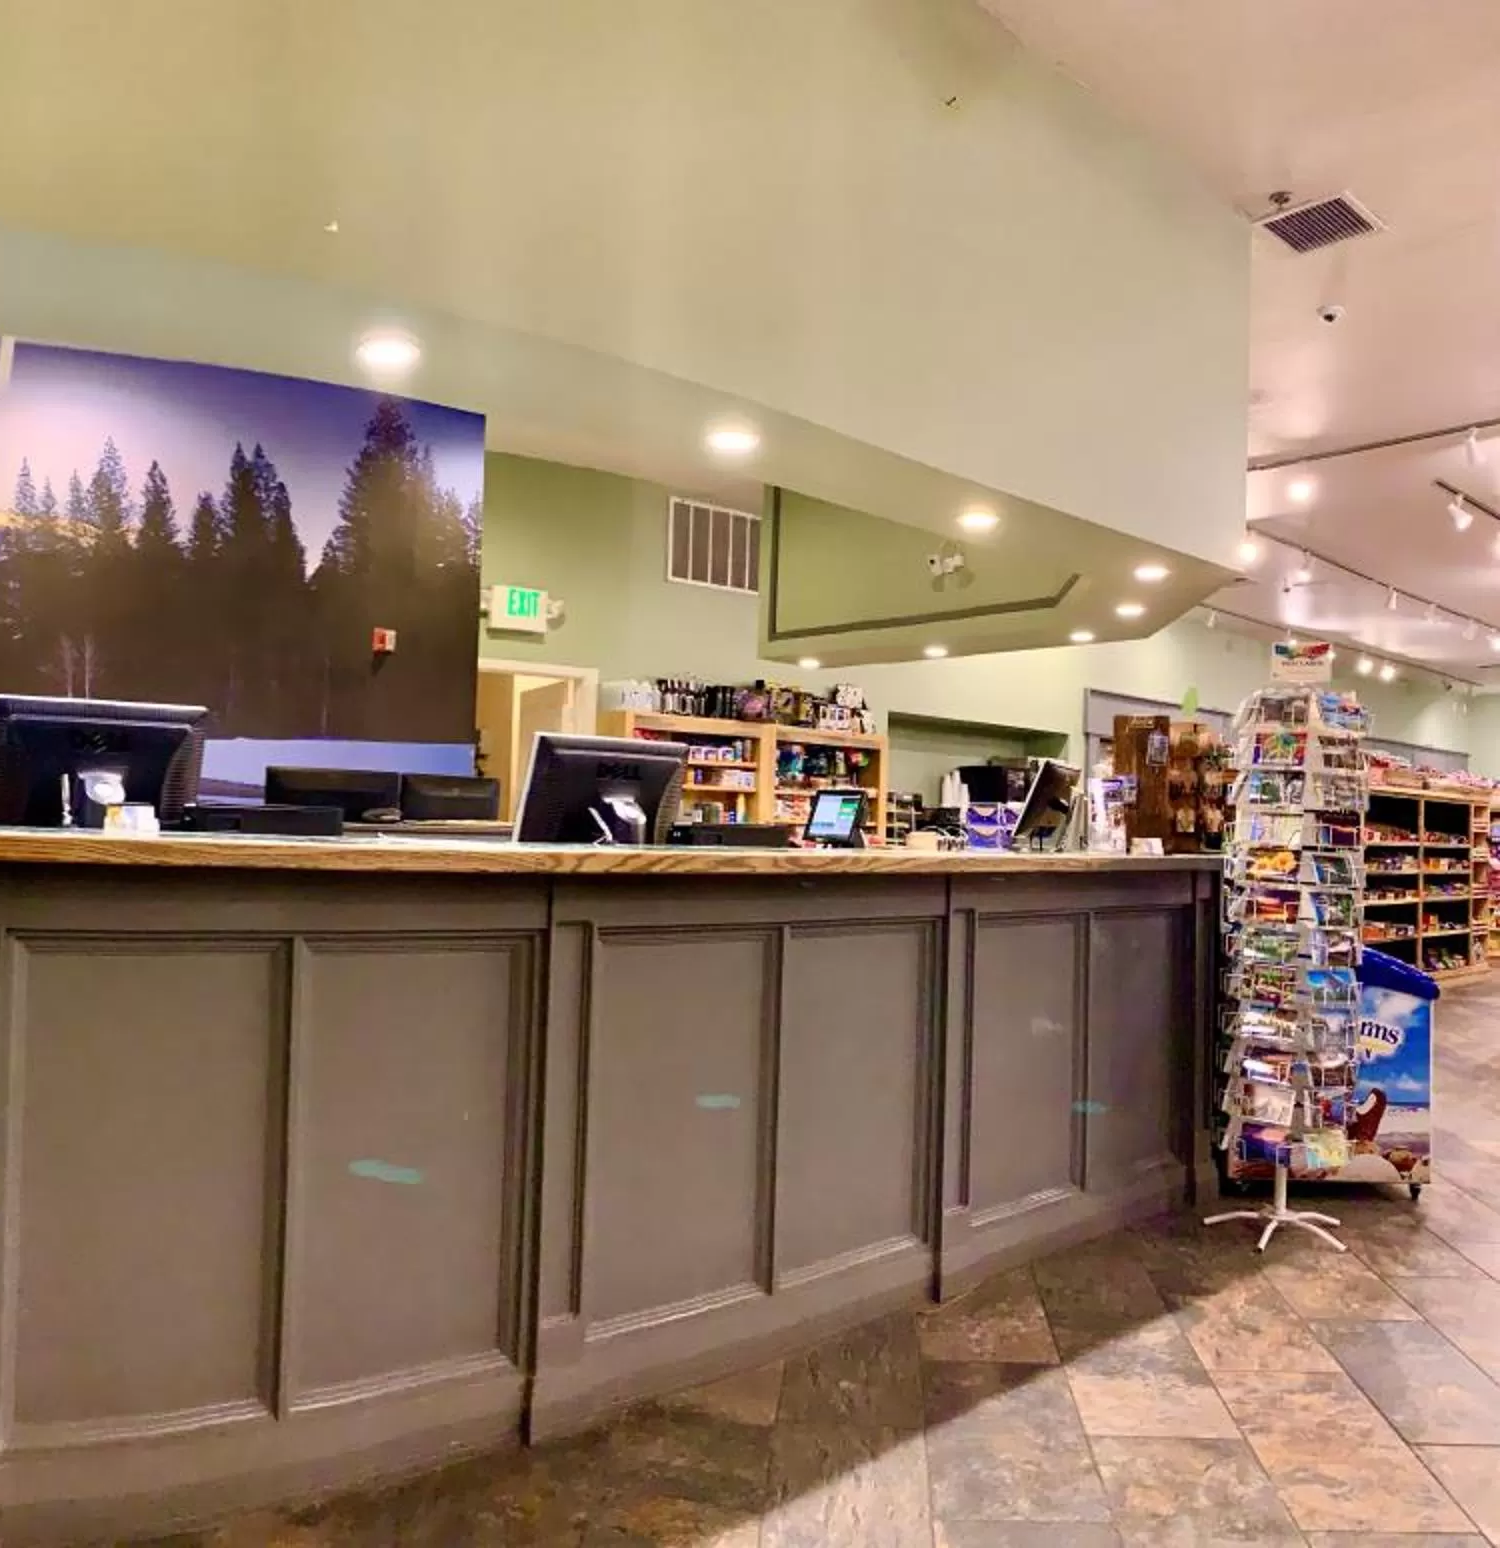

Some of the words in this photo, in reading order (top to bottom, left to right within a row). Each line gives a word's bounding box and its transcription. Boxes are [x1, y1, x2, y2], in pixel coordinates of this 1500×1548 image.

[507, 588, 541, 618] EXIT
[596, 762, 643, 781] DELL
[1360, 1021, 1400, 1045] rms
